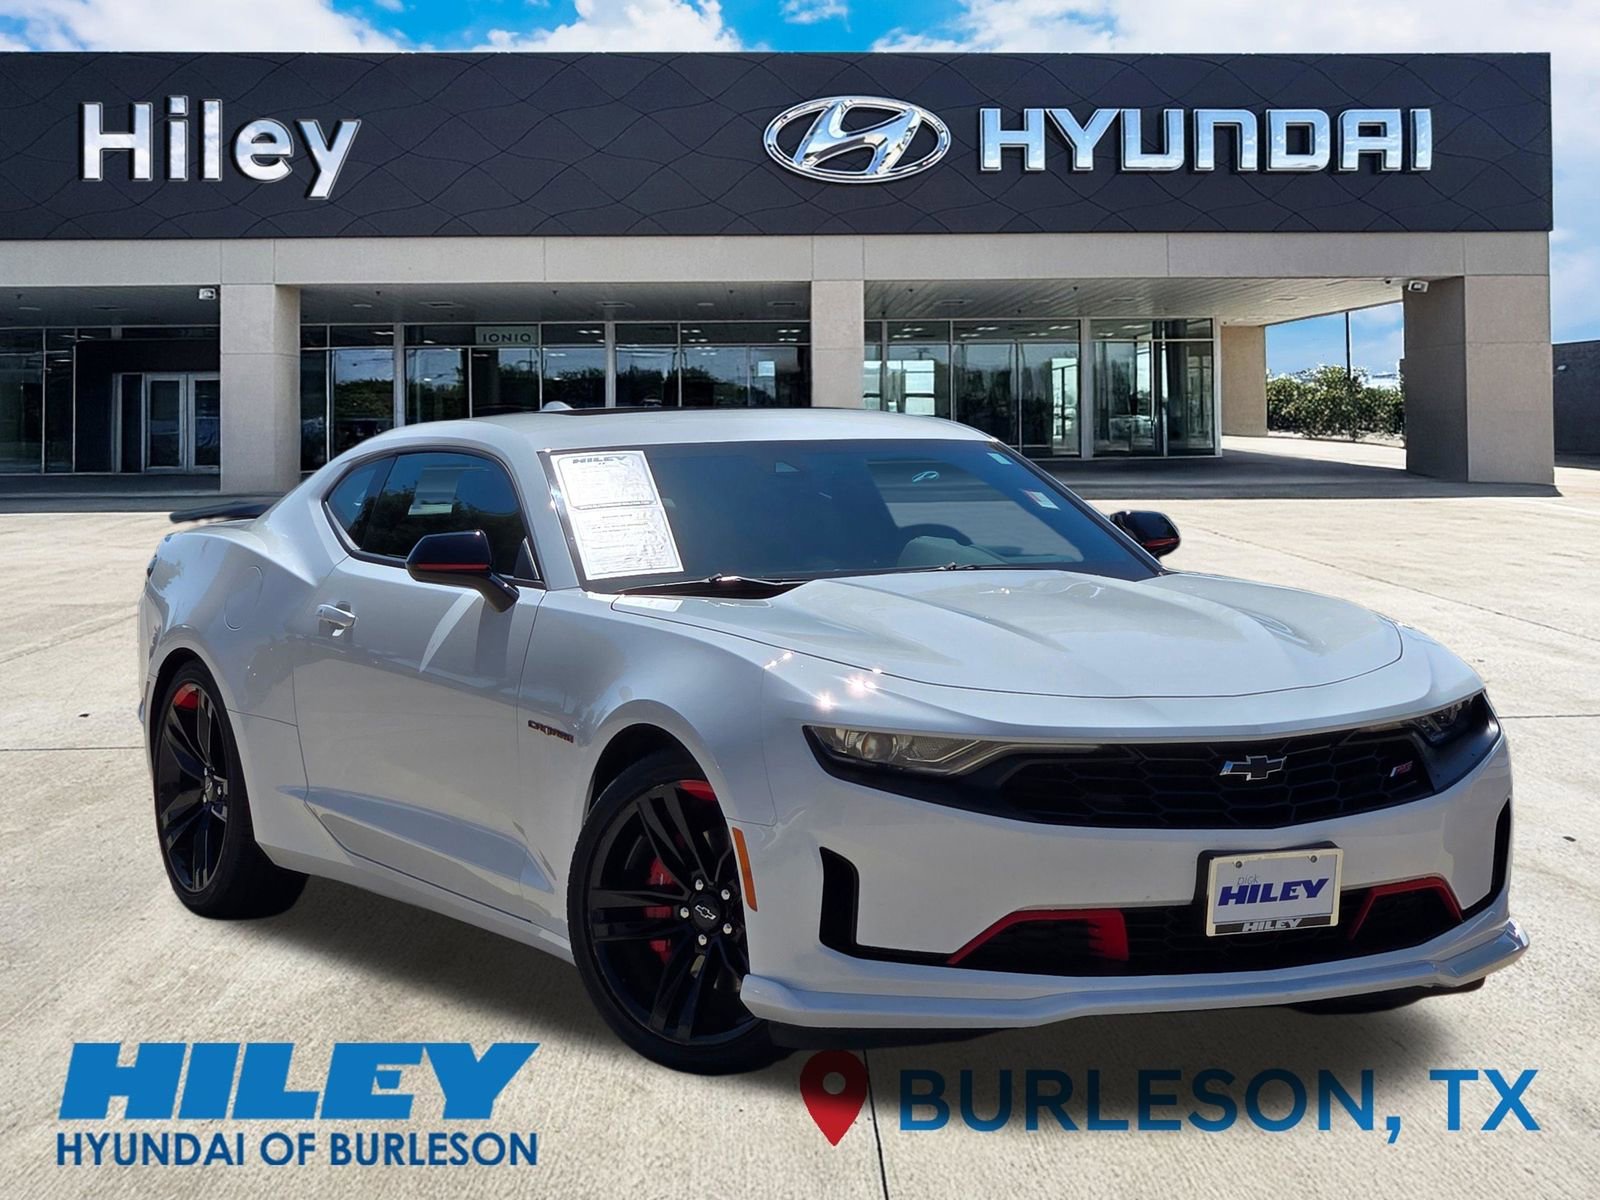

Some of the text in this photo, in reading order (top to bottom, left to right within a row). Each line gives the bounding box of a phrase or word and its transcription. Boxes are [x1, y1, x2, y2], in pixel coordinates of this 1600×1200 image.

[80, 95, 361, 200] Hiley
[978, 107, 1432, 173] HYUNDAI
[1218, 878, 1329, 906] HILEY
[1242, 918, 1303, 932] HILEY
